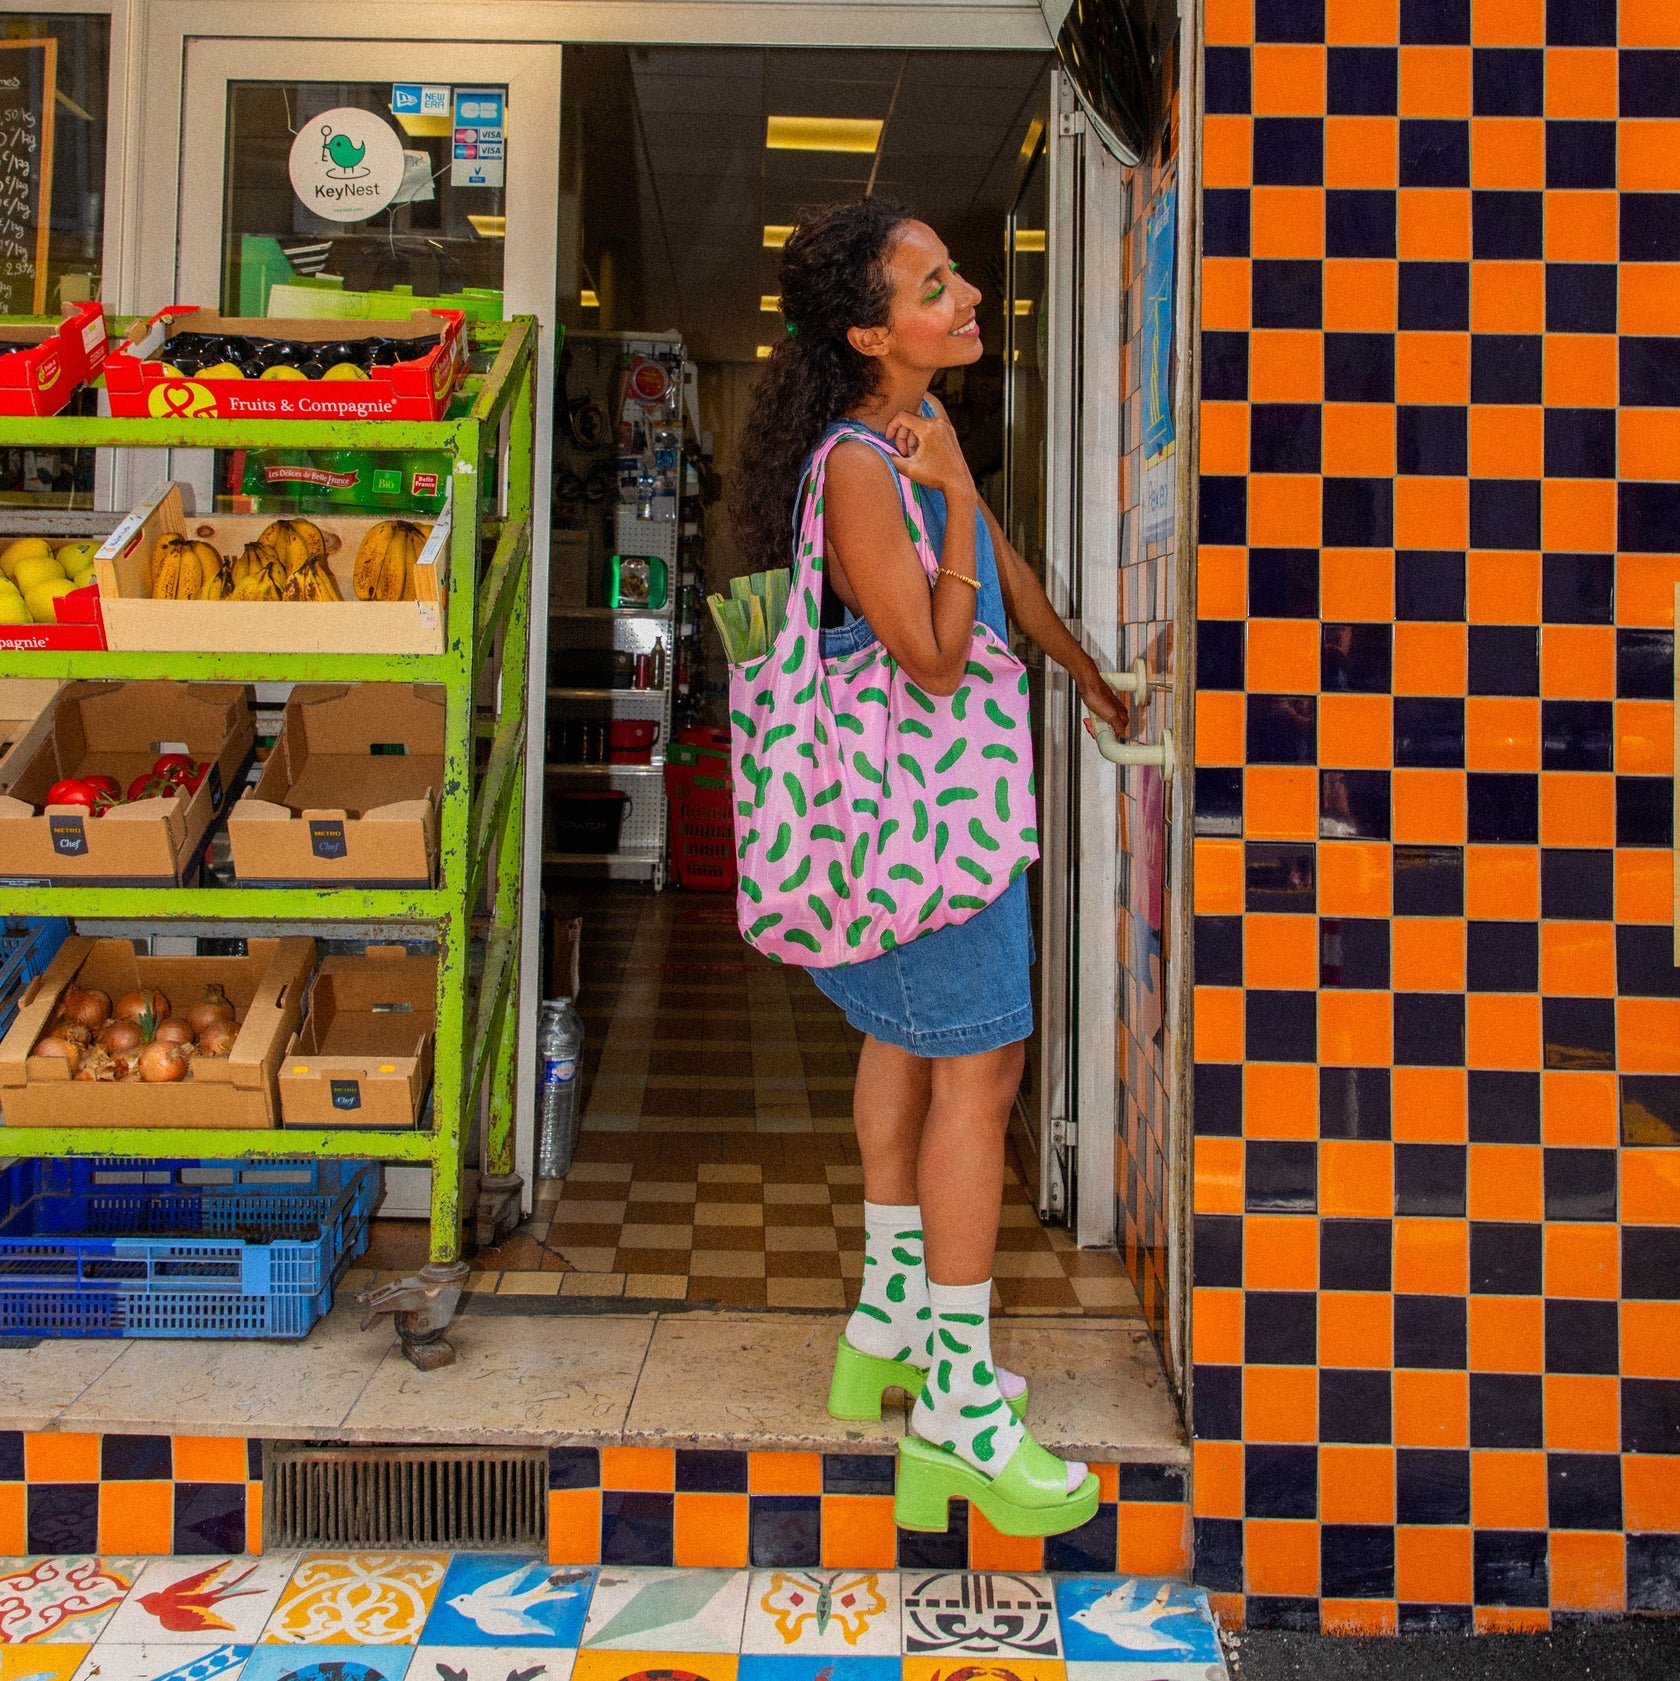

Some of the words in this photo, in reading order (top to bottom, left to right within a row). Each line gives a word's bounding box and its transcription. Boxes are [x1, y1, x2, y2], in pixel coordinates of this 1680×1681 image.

[424, 92, 445, 101] NEW
[424, 100, 445, 109] ERA
[482, 131, 501, 139] VISA
[481, 146, 501, 154] VISA
[315, 183, 380, 201] KeyNest
[229, 397, 276, 411] Fruits
[280, 399, 294, 412] &
[268, 470, 279, 478] Les
[279, 468, 302, 478] Délices
[311, 472, 328, 482] Belle
[328, 475, 351, 486] France
[418, 475, 434, 483] Belle
[59, 838, 82, 850] Chef
[319, 841, 341, 853] Chef
[337, 1096, 356, 1104] Chef
